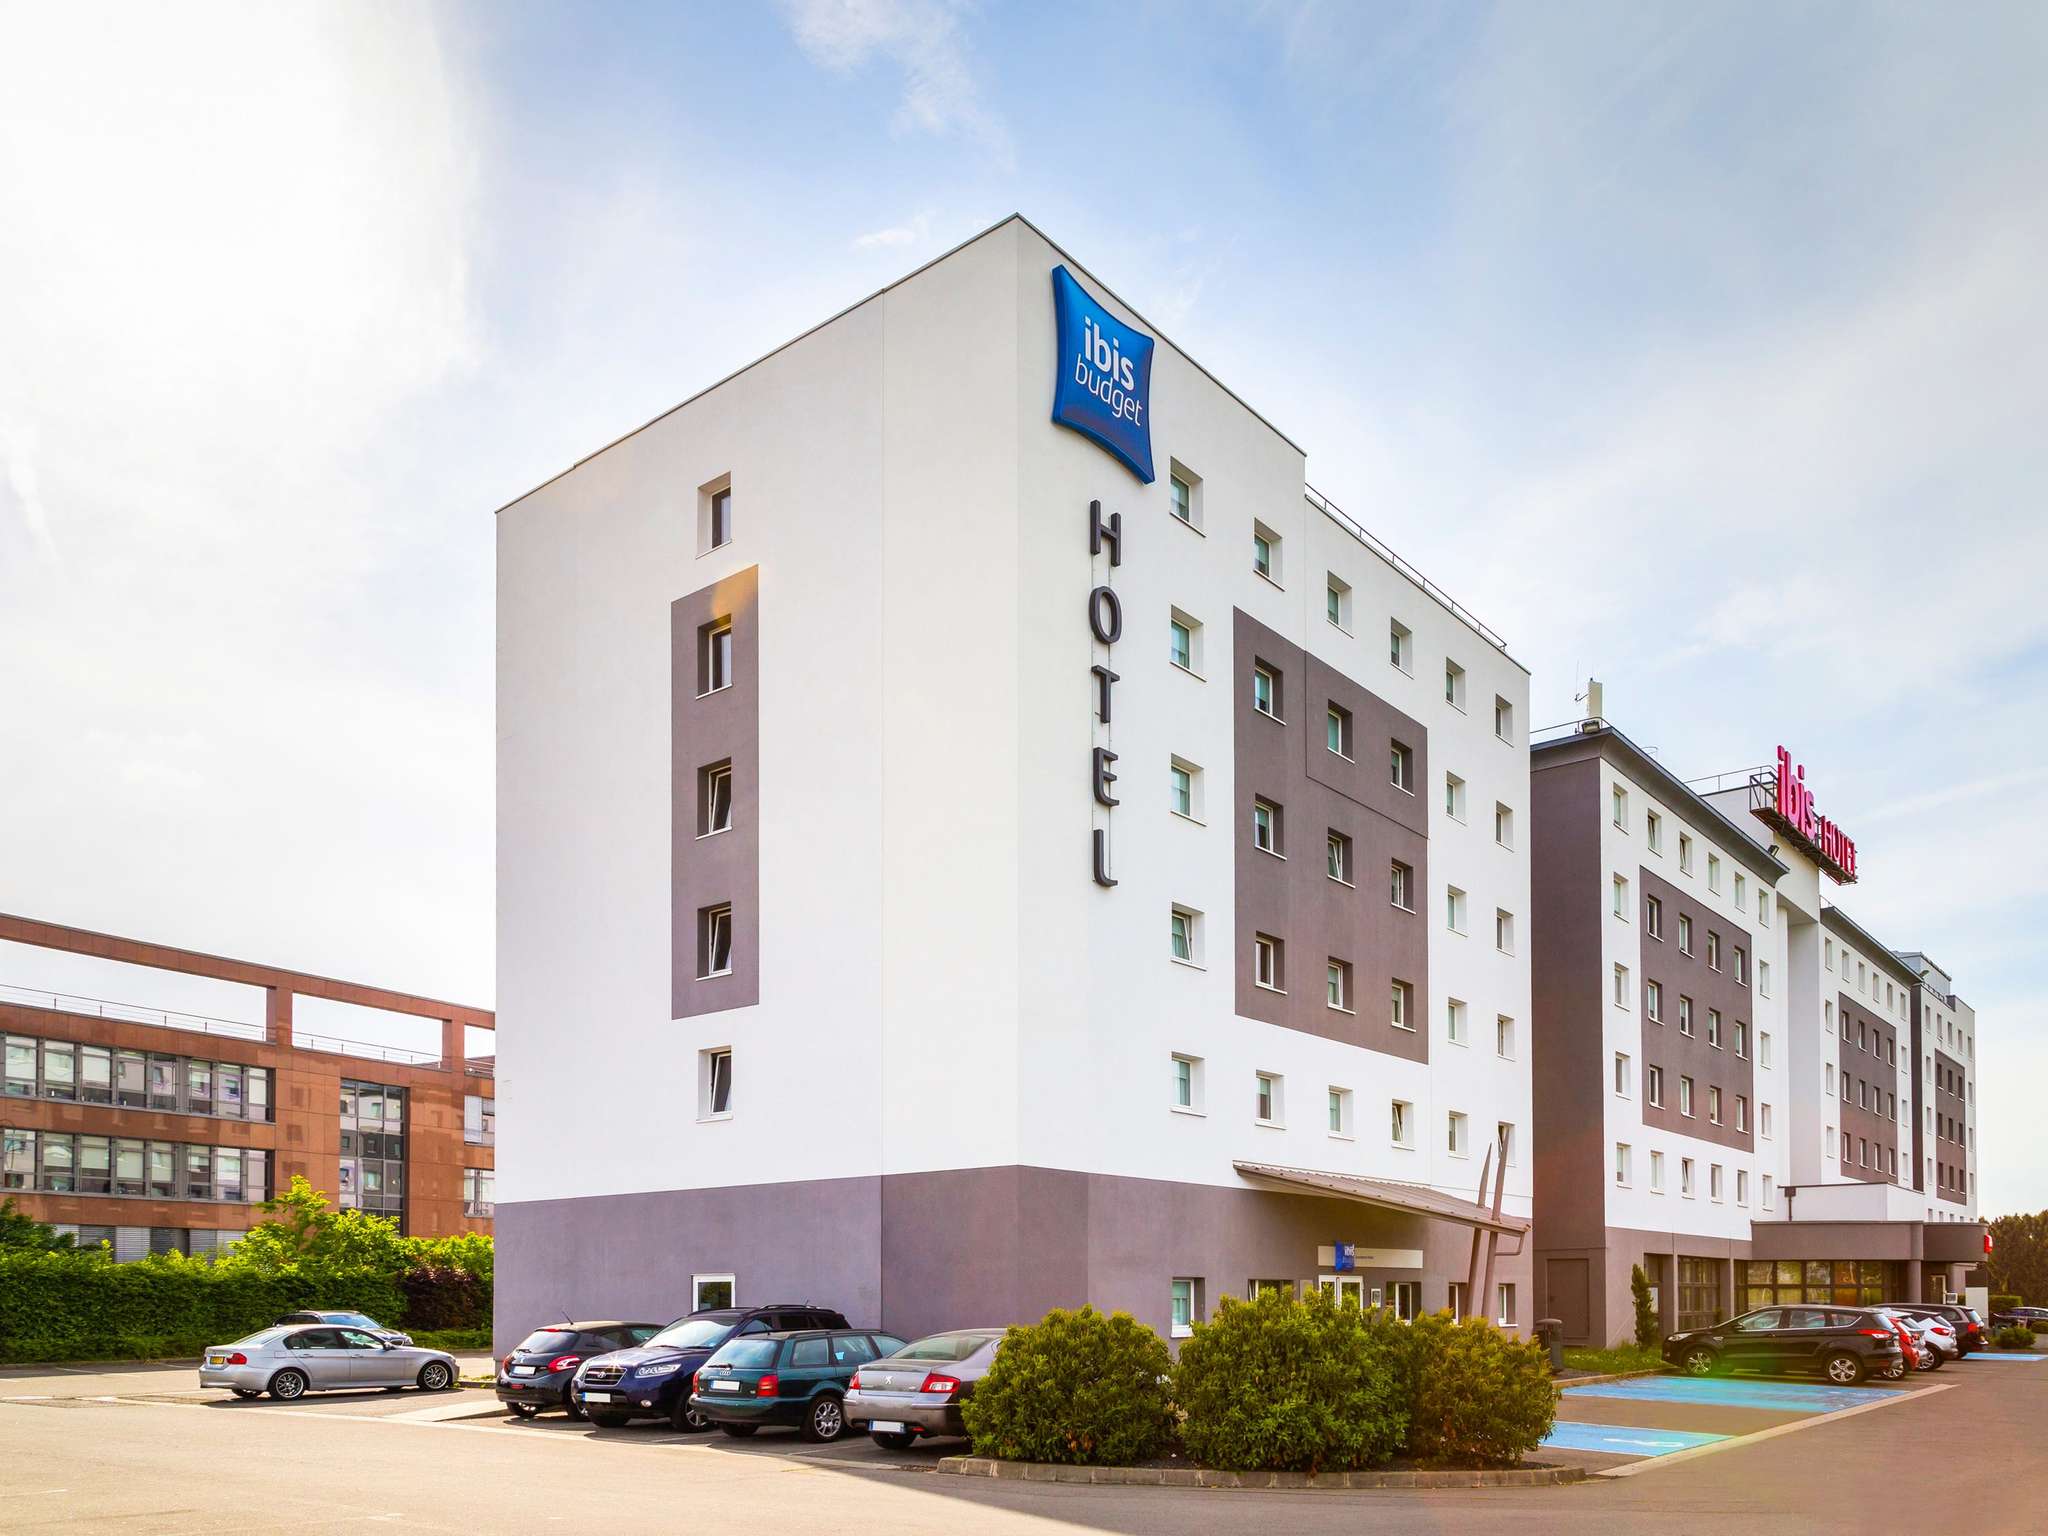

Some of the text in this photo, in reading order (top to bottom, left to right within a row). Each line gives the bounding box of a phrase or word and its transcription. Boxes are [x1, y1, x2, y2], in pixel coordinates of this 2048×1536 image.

[1074, 353, 1143, 427] budget
[1084, 315, 1135, 391] ibis
[1089, 499, 1122, 888] HOTEL
[1777, 745, 1815, 841] ibis
